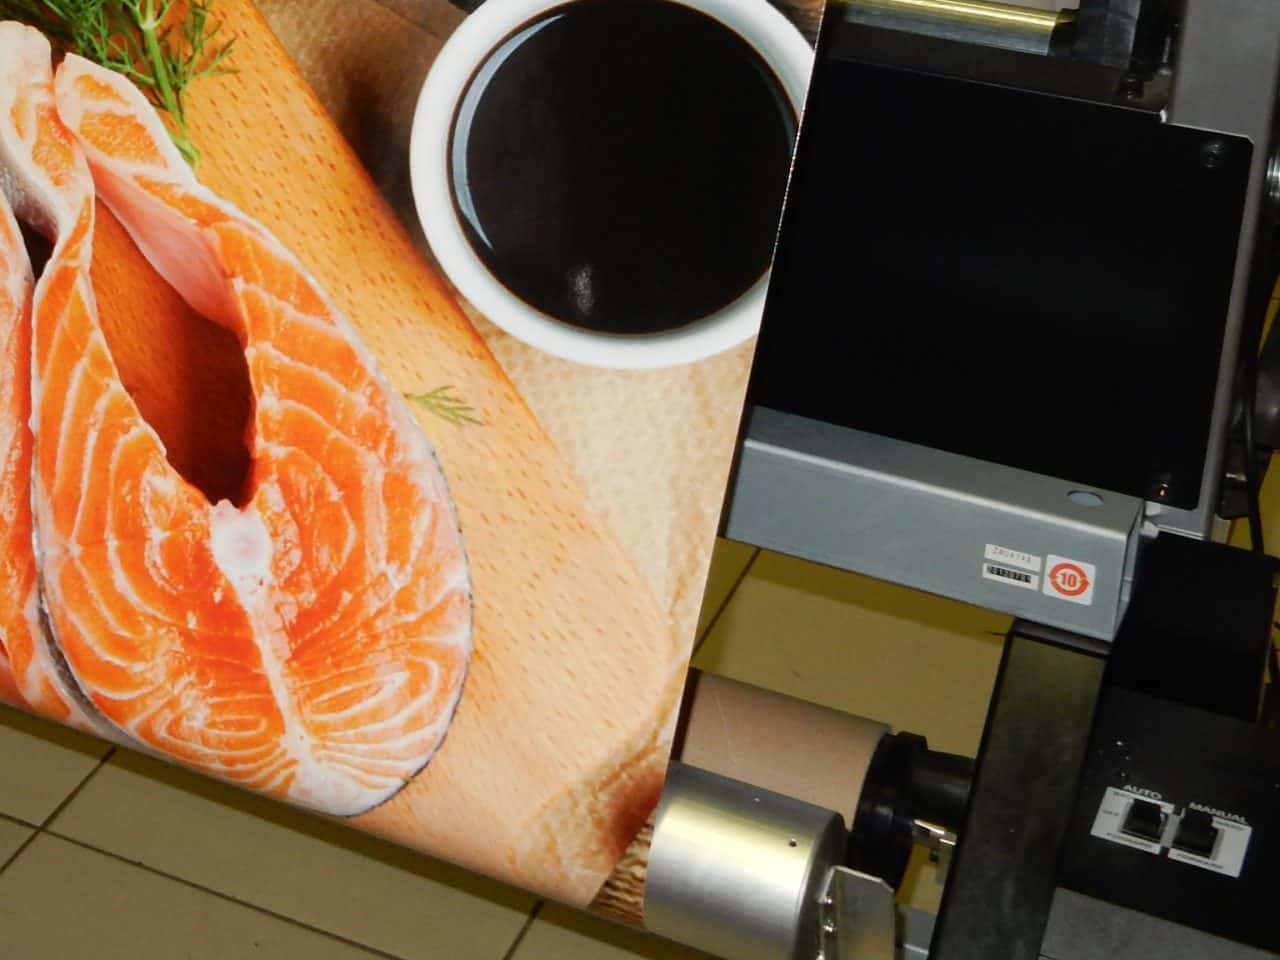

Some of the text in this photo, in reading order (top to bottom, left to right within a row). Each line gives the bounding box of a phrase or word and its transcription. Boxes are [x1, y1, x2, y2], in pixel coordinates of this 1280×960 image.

[1061, 571, 1078, 588] 10
[1123, 784, 1162, 800] AUTO
[1188, 801, 1249, 825] MANUAL
